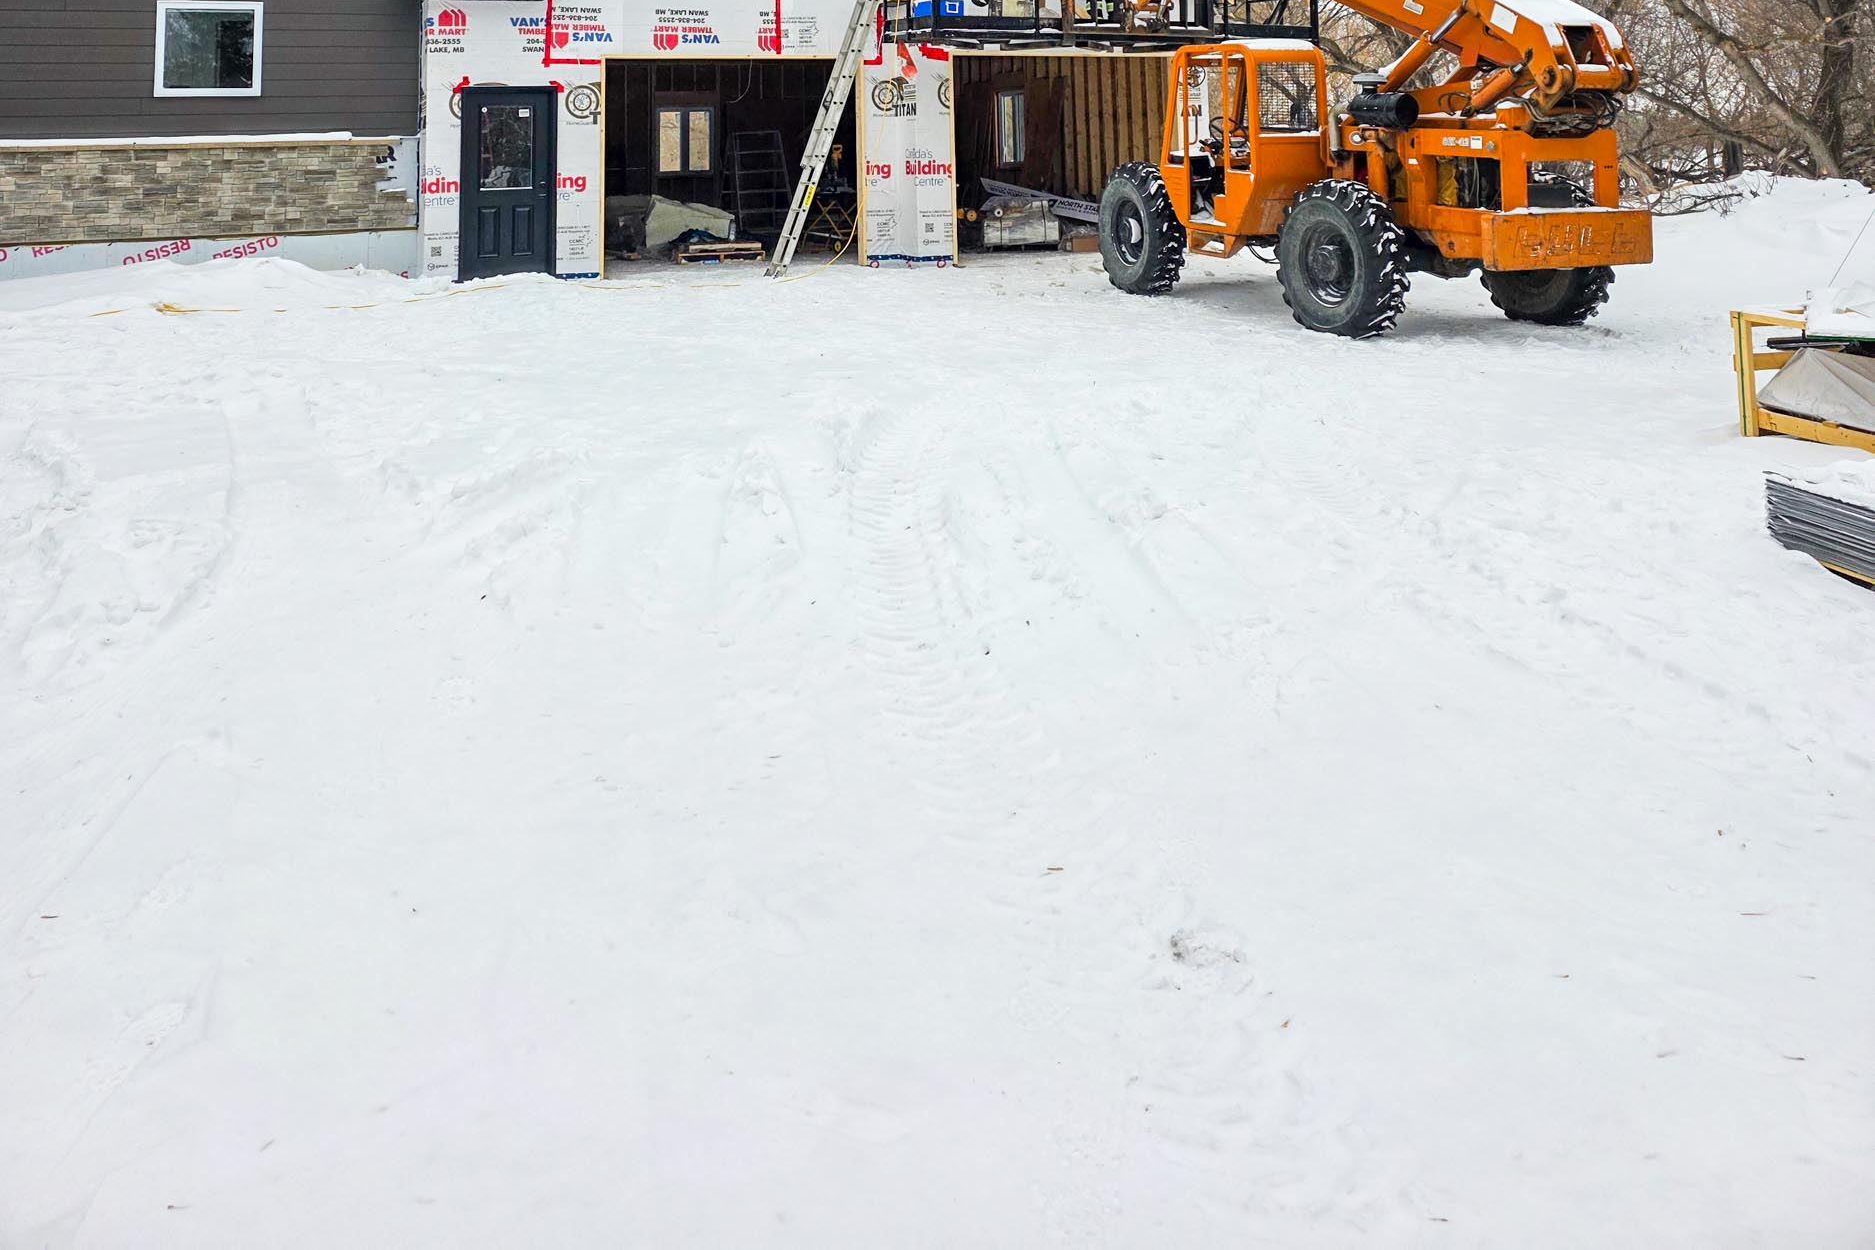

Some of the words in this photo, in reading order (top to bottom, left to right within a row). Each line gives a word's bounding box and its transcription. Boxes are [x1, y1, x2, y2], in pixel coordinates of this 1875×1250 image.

[438, 28, 466, 36] MART
[572, 24, 606, 32] TIMBER
[653, 25, 679, 33] MART
[681, 26, 713, 34] TIMBER
[572, 32, 613, 42] VAN'S
[681, 34, 720, 44] VAN'S
[429, 46, 450, 54] LAKE,
[892, 102, 917, 117] TITAN
